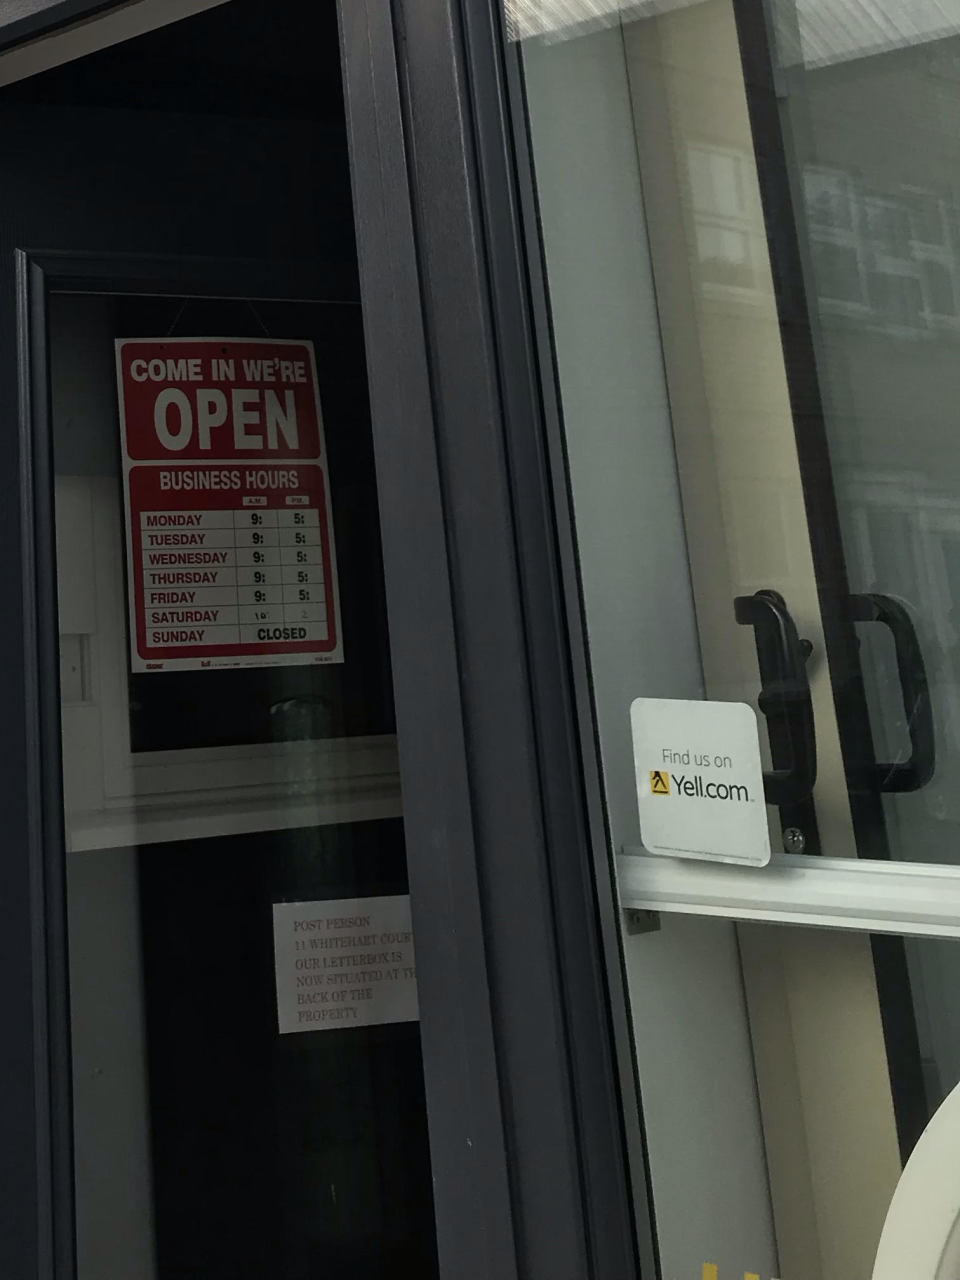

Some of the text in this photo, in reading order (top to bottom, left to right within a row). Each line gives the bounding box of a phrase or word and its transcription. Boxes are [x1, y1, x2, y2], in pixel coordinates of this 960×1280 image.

[130, 357, 307, 383] COME IN WE'RE
[153, 387, 299, 451] OPEN
[159, 471, 299, 491] BUSINESS HOURS
[146, 515, 202, 527] MONDAY
[148, 533, 206, 546] TUESDAY
[149, 552, 228, 565] WEDNESDAY
[150, 571, 218, 585] THURSDAY
[150, 591, 196, 604] FRIDAY
[151, 610, 219, 623] SATURDAY
[152, 628, 307, 643] SUNDAY CLOSED
[662, 749, 732, 768] Find us on
[671, 773, 749, 802] Yell.com
[294, 916, 371, 932] POST PERSON
[295, 951, 402, 970] OUR LETTERBOX IS
[296, 975, 323, 988] NOW
[326, 970, 383, 985] SITUATED
[385, 969, 399, 981] AT
[297, 988, 373, 1005] BACK OF THE
[297, 1007, 358, 1023] PROPERTY
